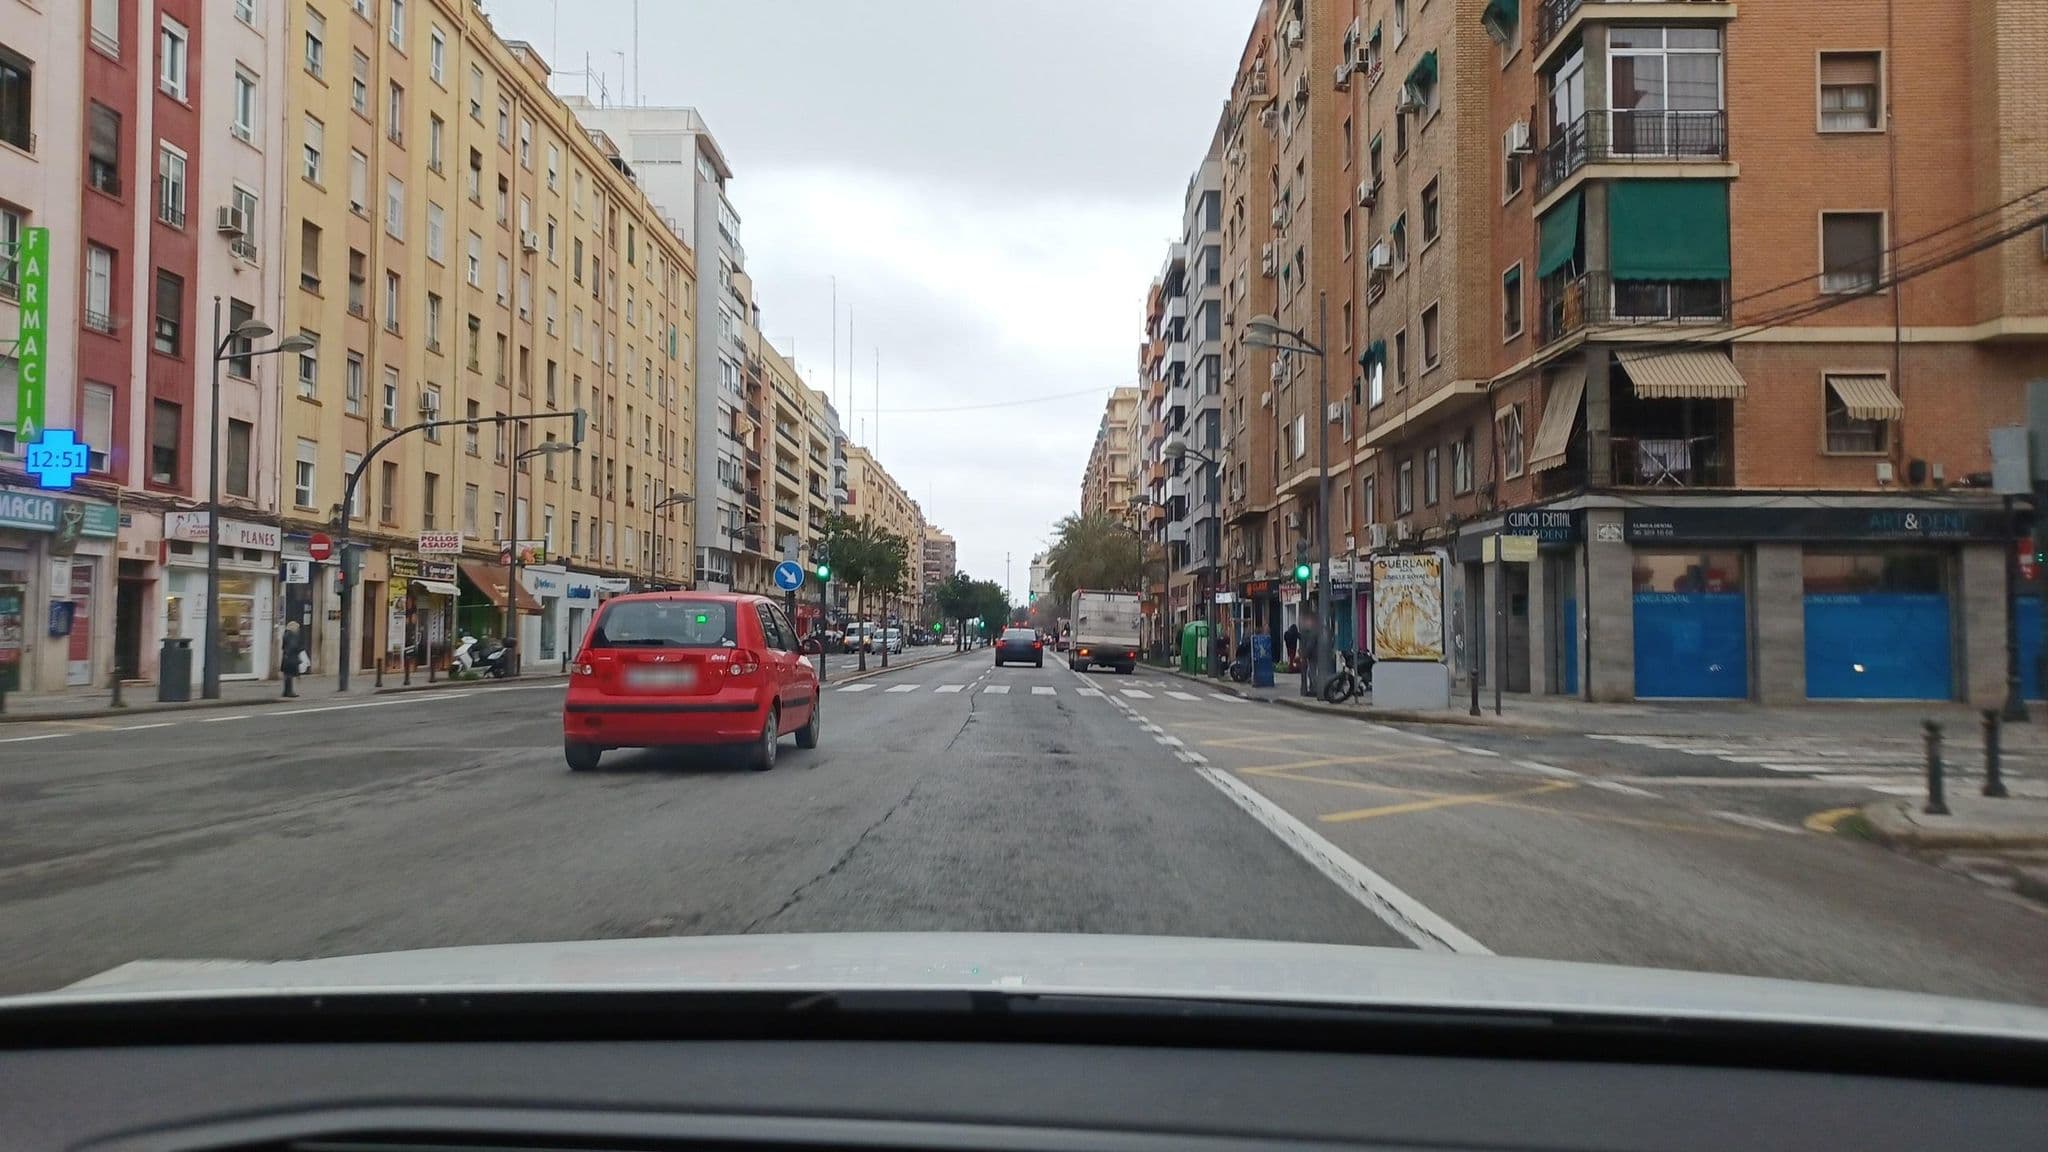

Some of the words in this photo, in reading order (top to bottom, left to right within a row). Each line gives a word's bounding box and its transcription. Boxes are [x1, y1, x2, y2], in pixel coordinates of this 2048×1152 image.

[20, 230, 40, 437] FARMACIA
[31, 450, 84, 467] 12:51
[1508, 512, 1539, 527] CLINICA
[1542, 512, 1572, 527] DENTAL
[241, 529, 275, 547] PLANES
[421, 541, 459, 549] ASADOS
[1379, 559, 1435, 569] GUERLAIN
